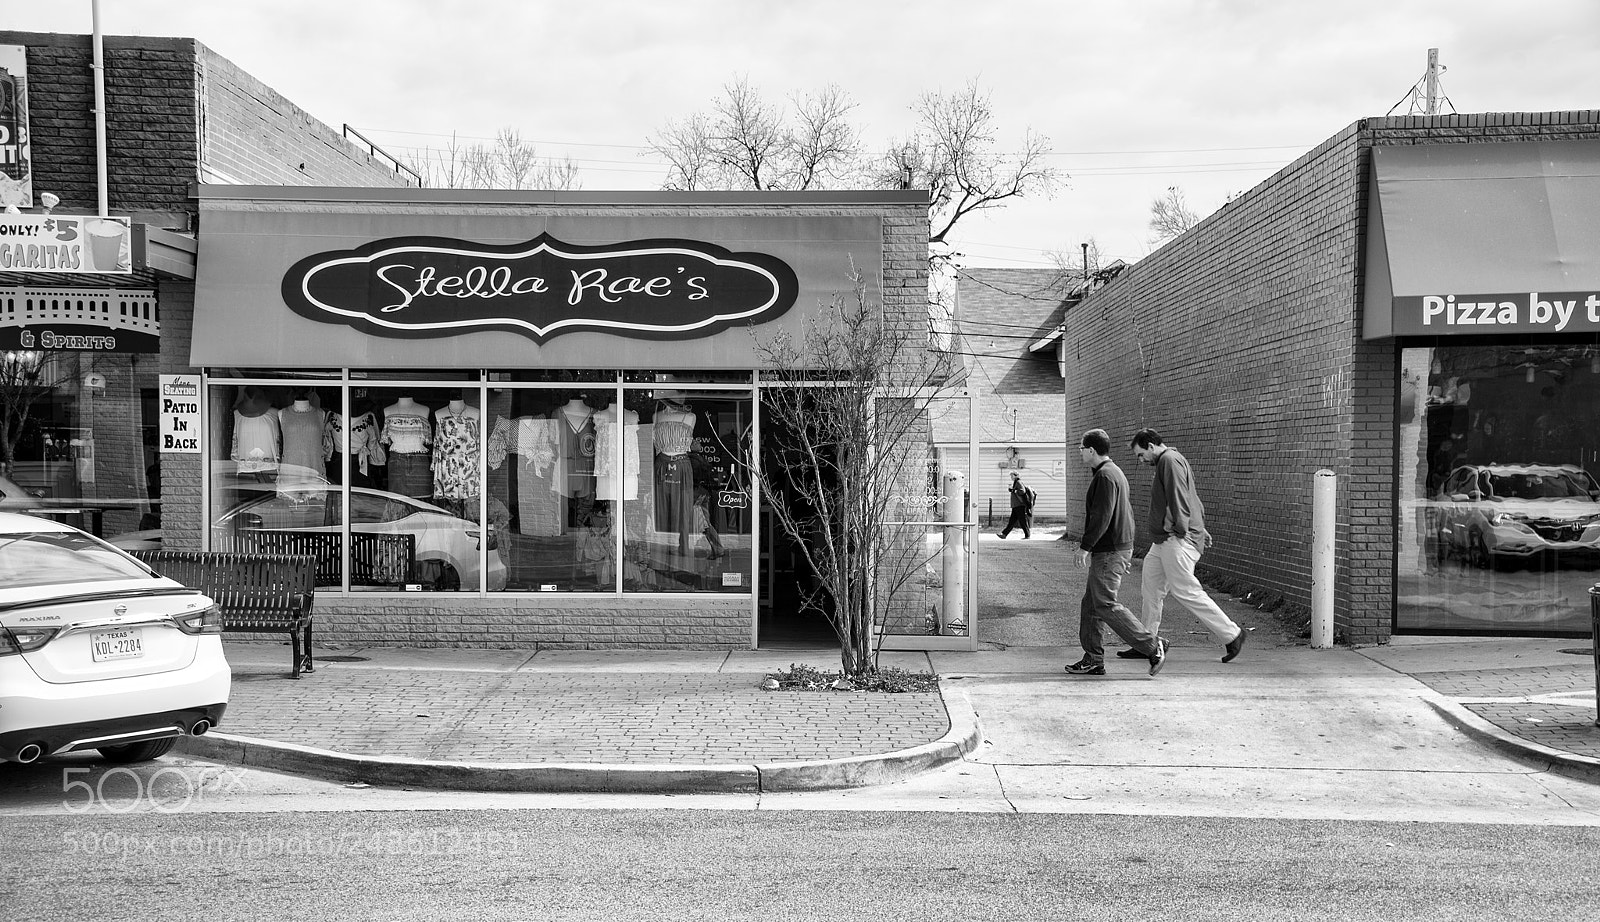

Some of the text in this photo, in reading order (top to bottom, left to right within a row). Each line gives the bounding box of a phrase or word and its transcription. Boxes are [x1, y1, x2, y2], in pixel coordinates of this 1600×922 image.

[0, 218, 79, 242] ONLY! $5
[376, 264, 710, 313] Stella Rae's
[1422, 294, 1518, 326] Pizza
[1529, 292, 1577, 332] by
[21, 330, 116, 350] & SPIRITS
[164, 385, 196, 395] SEATING
[163, 399, 198, 414] PATIO
[173, 417, 188, 431] IN
[164, 434, 198, 449] BACK
[723, 494, 742, 505] Open
[19, 614, 61, 623] MAXIMA
[107, 631, 128, 639] TEXAS
